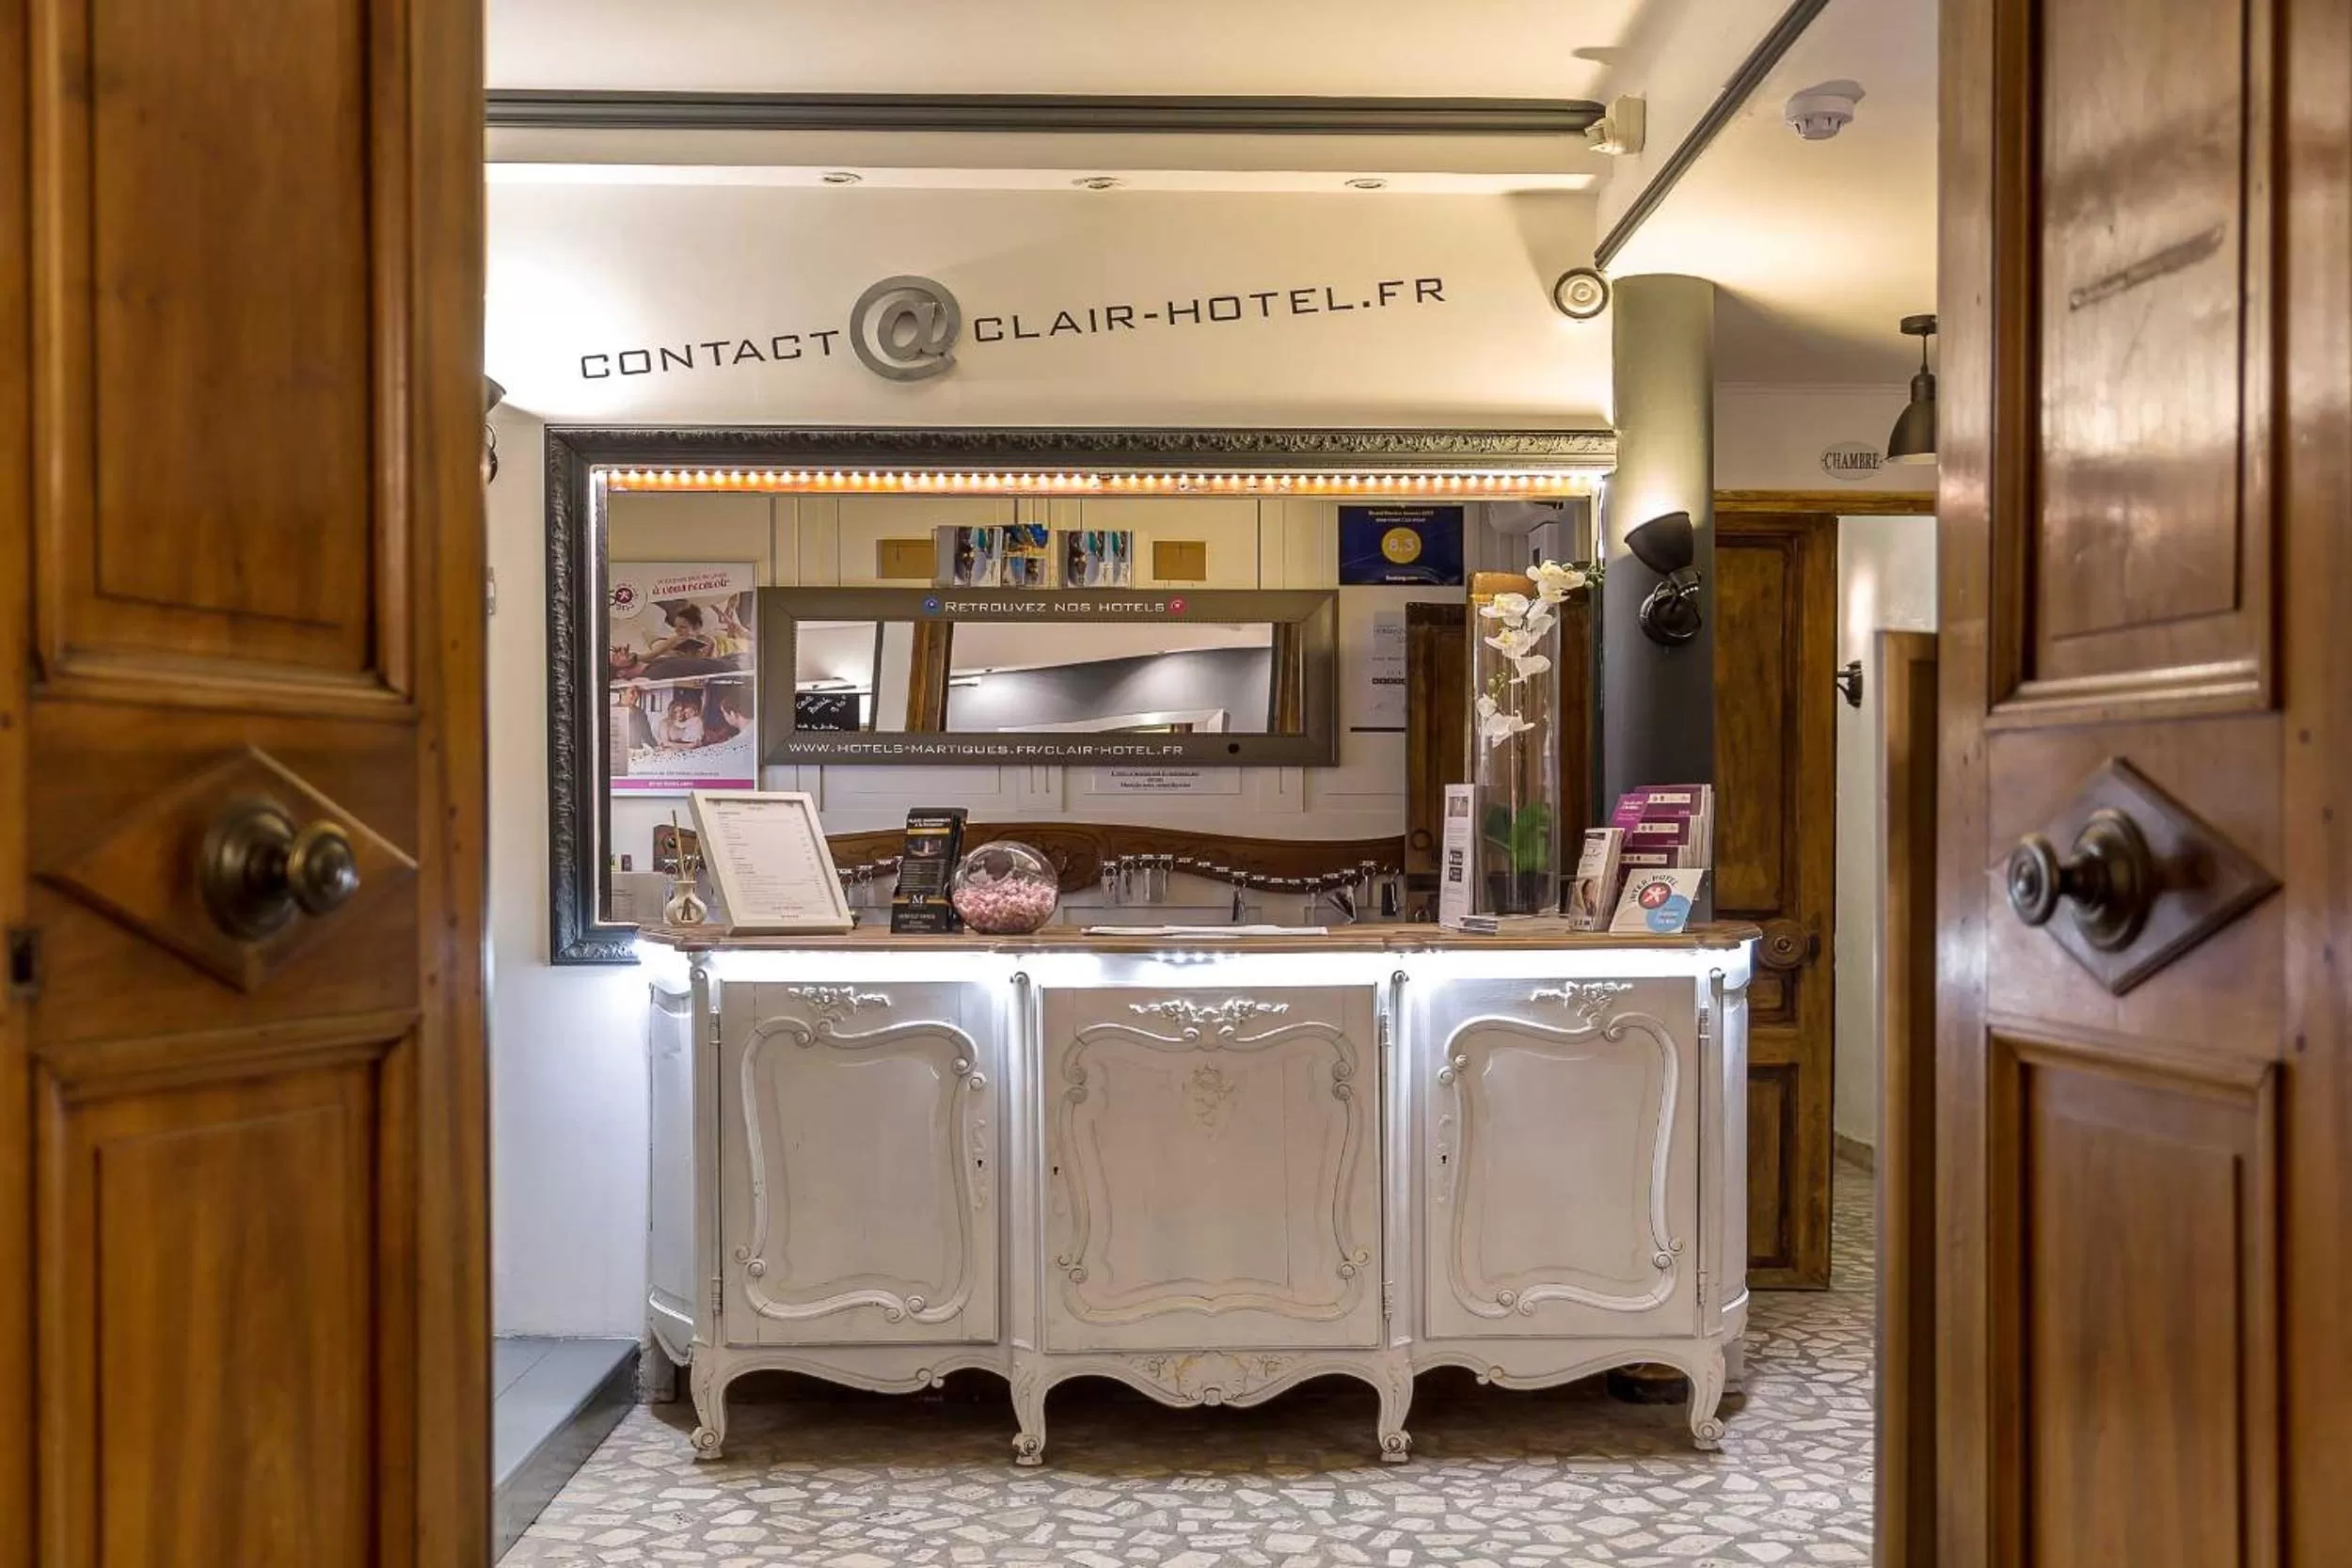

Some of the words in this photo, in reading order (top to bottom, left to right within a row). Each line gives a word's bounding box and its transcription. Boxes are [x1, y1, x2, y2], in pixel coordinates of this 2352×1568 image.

[1824, 451, 1880, 469] CHAMBRE
[945, 601, 1047, 612] RETROUVEZ
[1054, 602, 1091, 612] NOS
[1099, 602, 1165, 612] HOTELS
